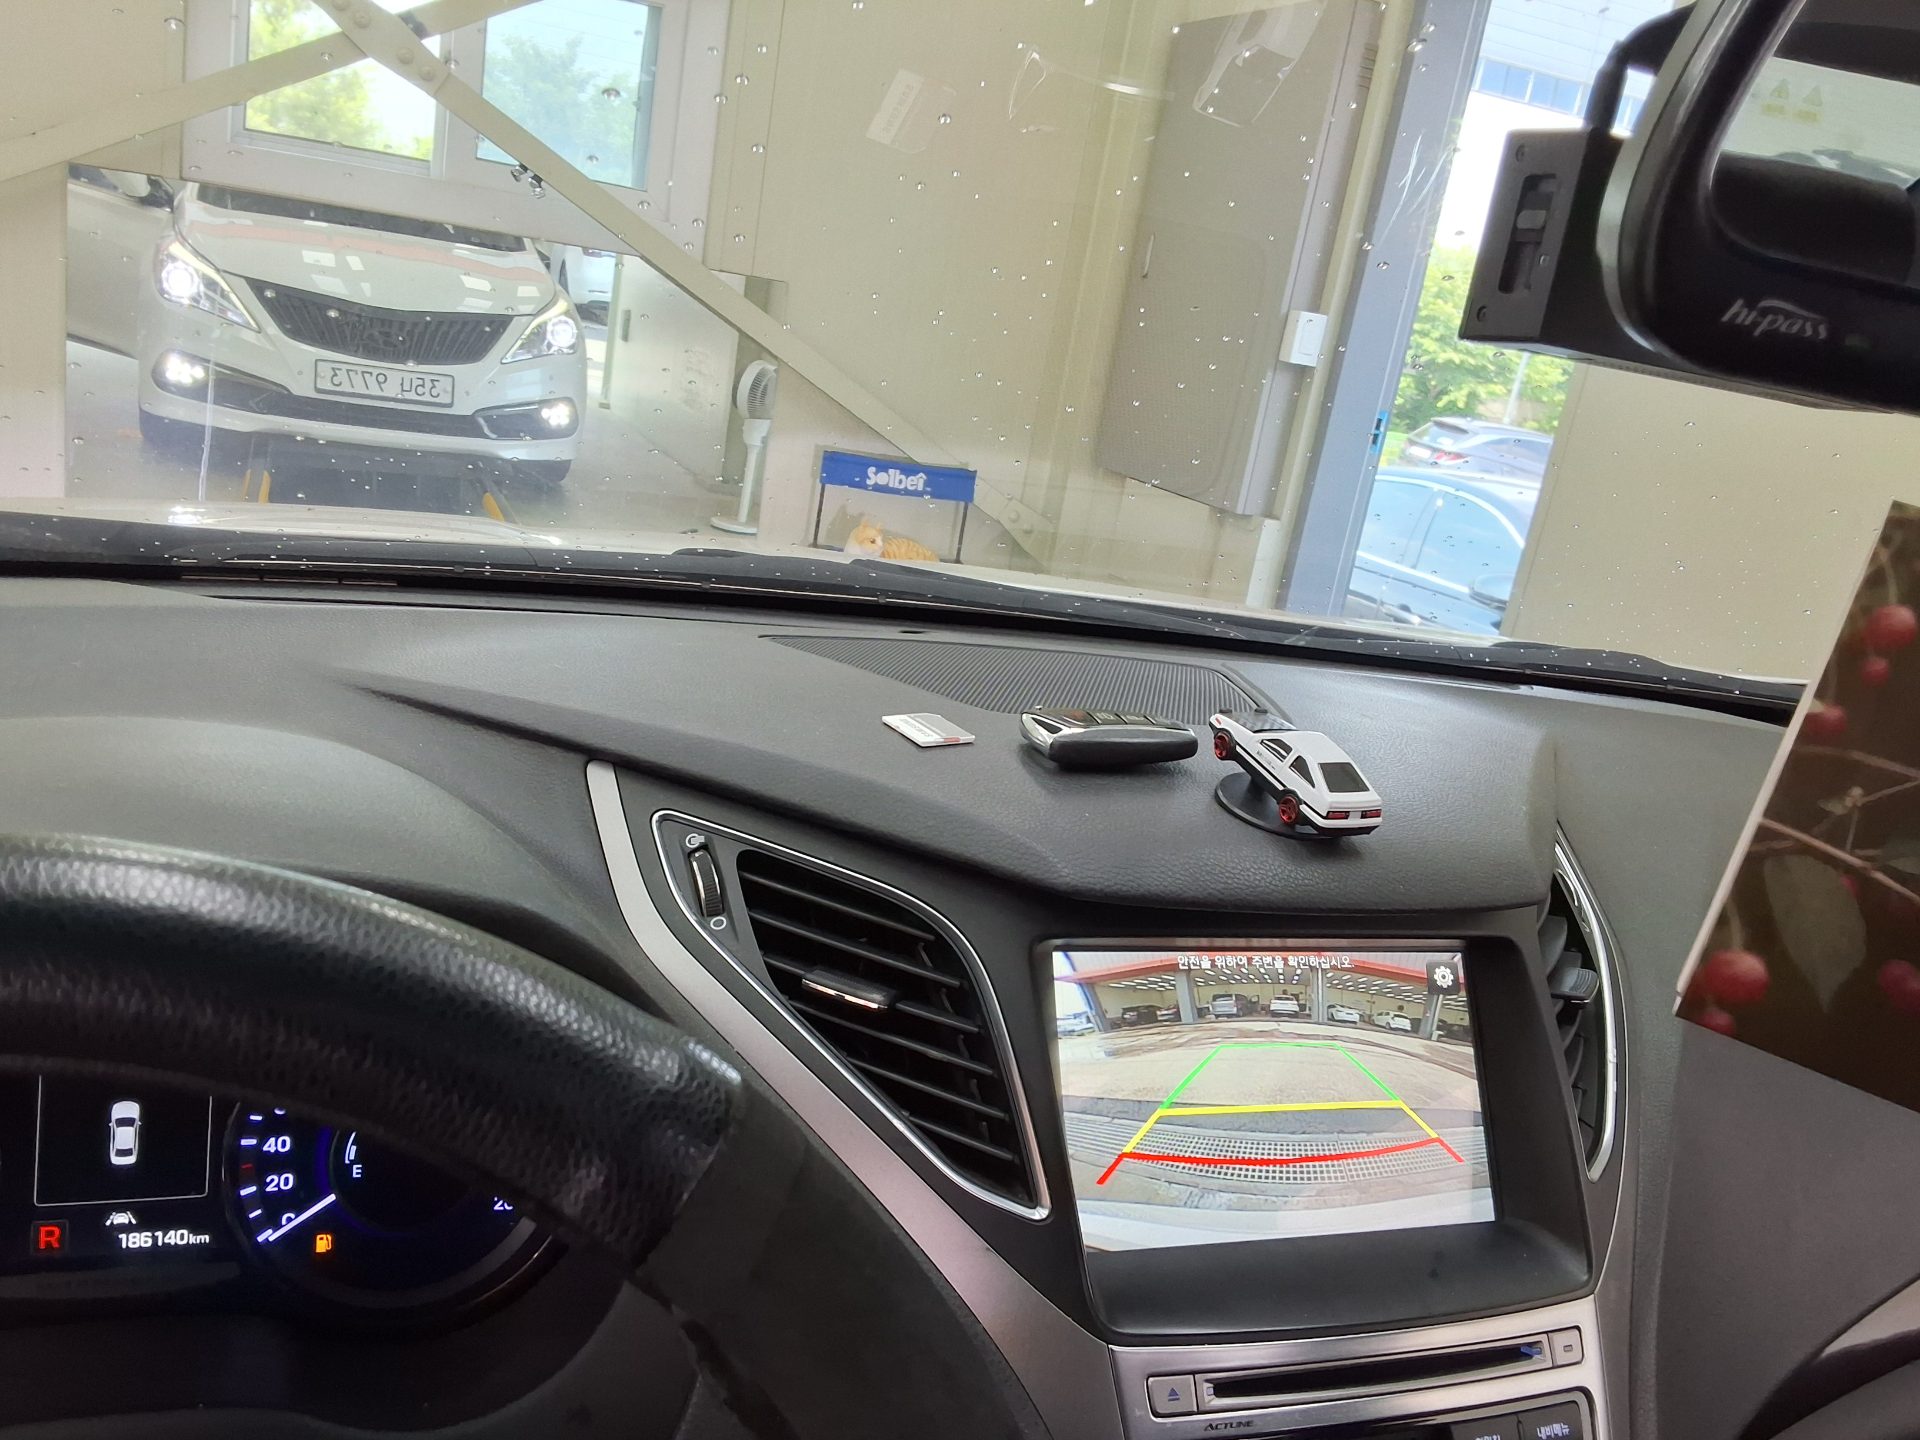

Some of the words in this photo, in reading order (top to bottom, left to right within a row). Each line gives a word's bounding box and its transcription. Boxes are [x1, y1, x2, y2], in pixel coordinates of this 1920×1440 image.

[1177, 955, 1211, 970] 안전을
[1214, 955, 1248, 969] 위하여
[1252, 955, 1285, 969] 주변을
[262, 1136, 291, 1153] 40
[352, 1164, 363, 1178] E
[265, 1173, 294, 1192] 20
[38, 1225, 62, 1249] R
